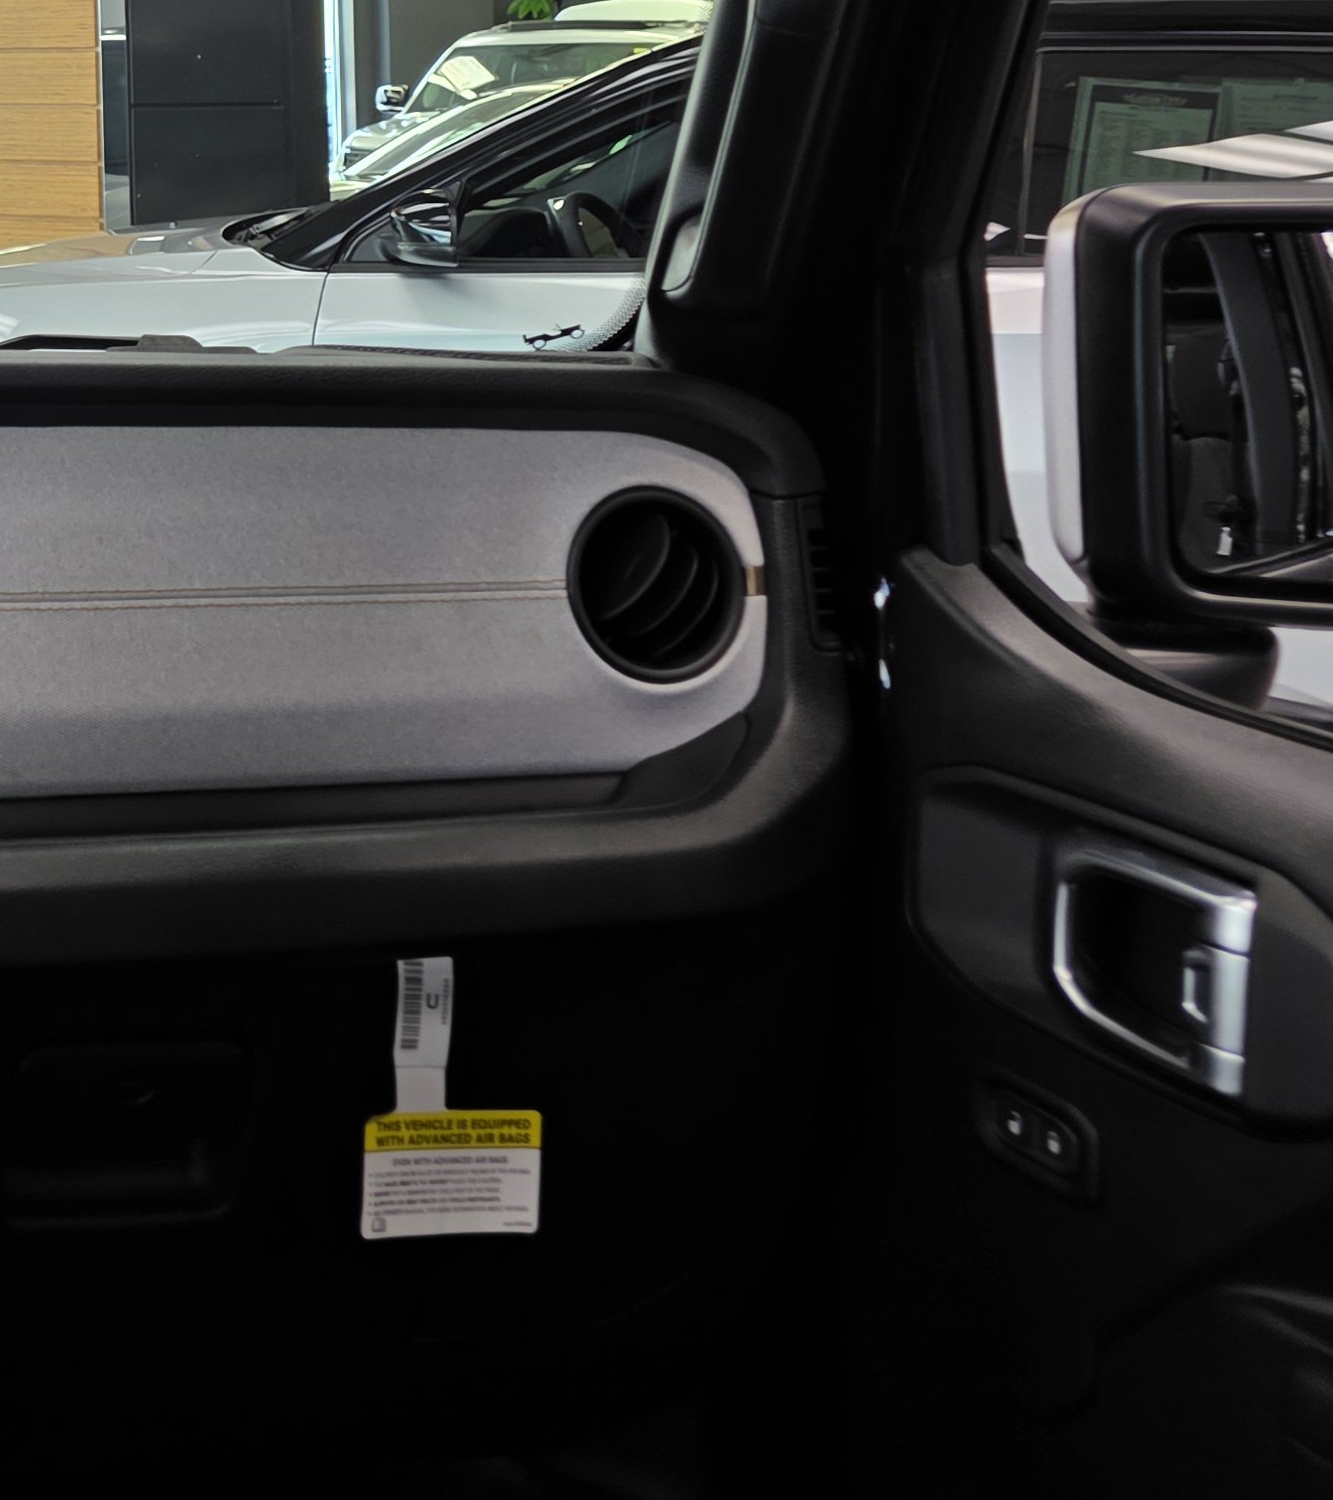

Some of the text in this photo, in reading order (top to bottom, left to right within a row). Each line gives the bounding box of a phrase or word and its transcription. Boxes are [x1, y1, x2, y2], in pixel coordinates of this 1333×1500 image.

[375, 1118, 531, 1132] THIS VEHICLE IS EQUIPPED
[375, 1132, 531, 1147] WITH ADVANCED AIR BAGS
